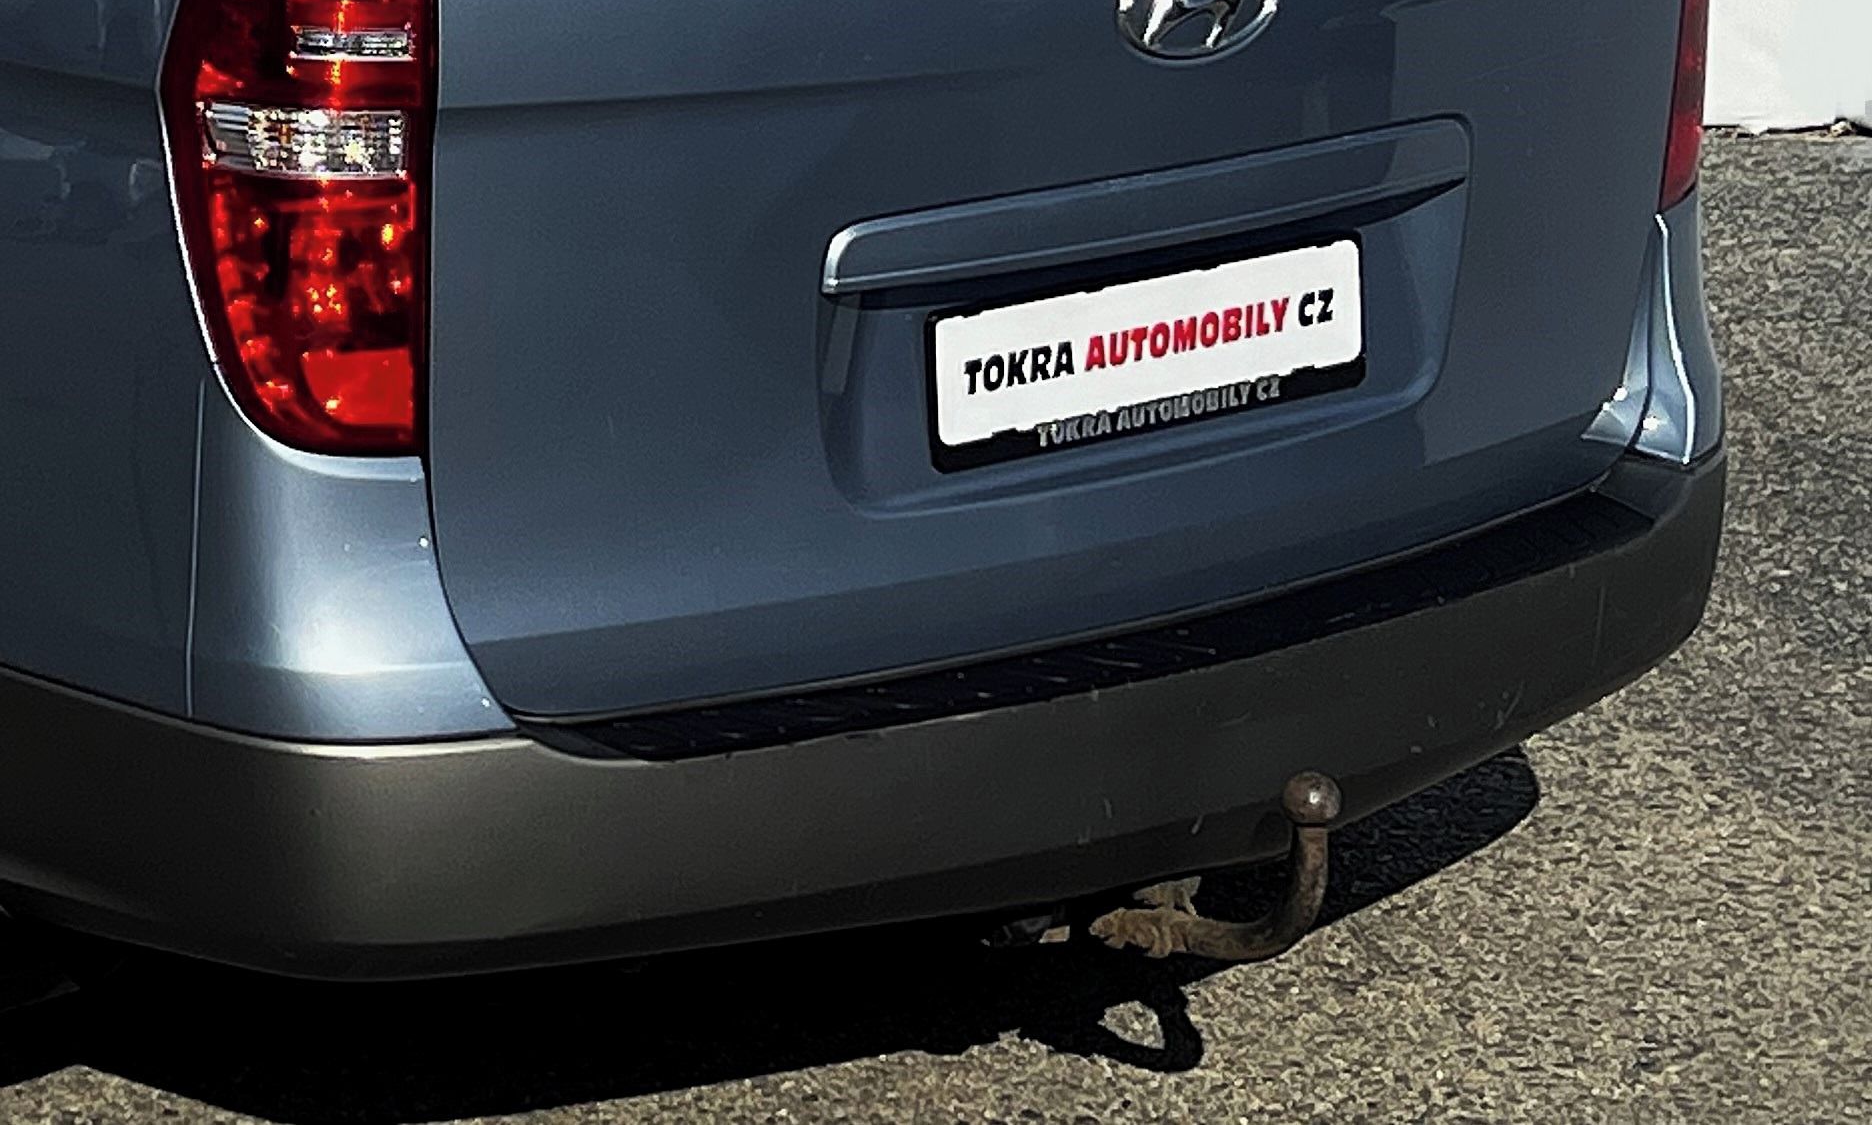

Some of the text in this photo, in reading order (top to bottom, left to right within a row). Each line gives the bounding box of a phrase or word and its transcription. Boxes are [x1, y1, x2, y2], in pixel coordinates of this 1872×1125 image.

[964, 287, 1335, 395] TOKRA AUTOMOBILY CZ
[1036, 374, 1281, 448] TOKRA AUTOMOBILY CZ
